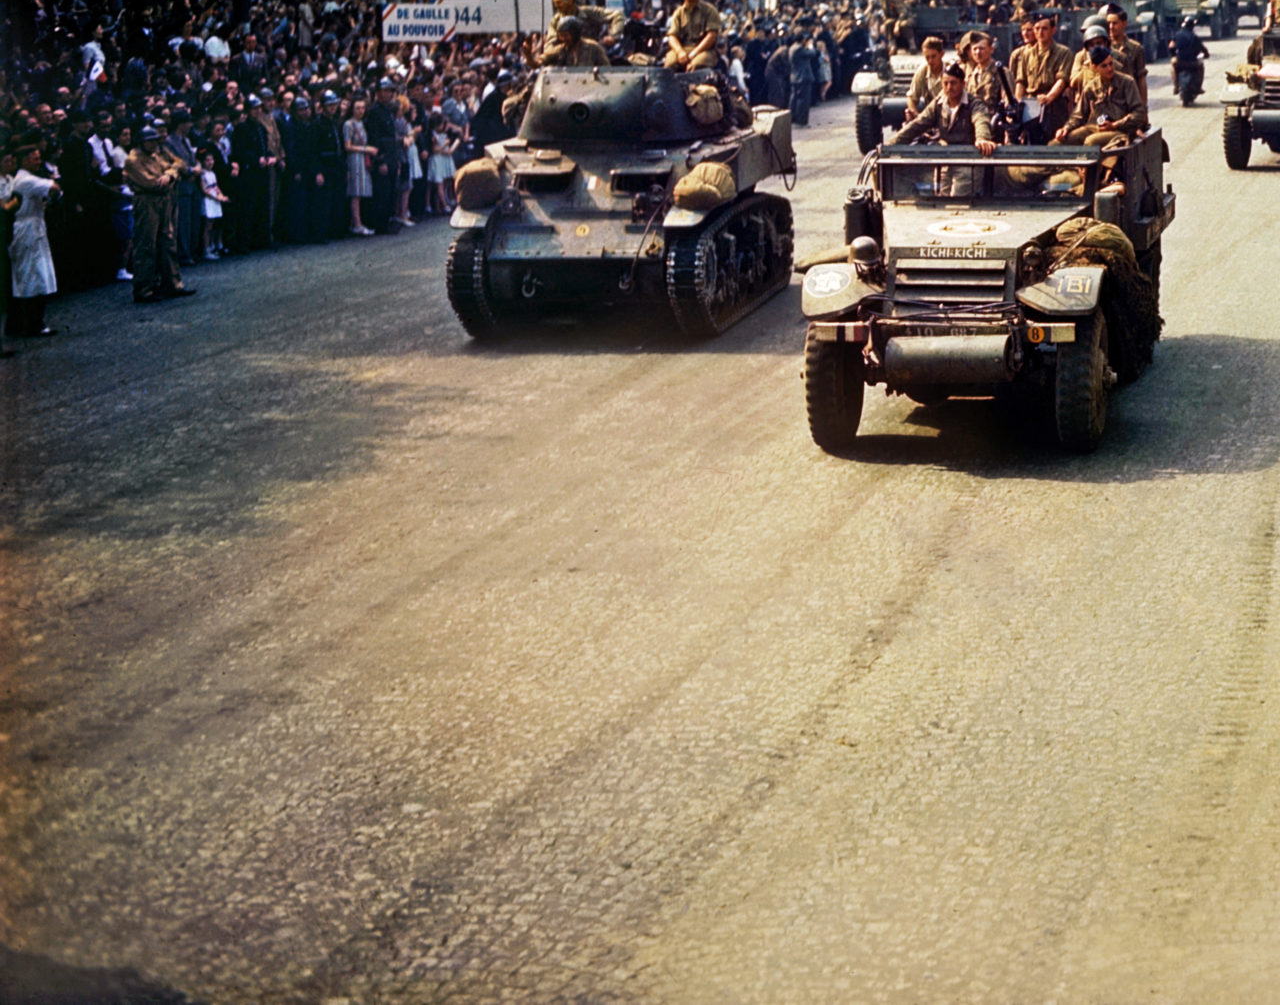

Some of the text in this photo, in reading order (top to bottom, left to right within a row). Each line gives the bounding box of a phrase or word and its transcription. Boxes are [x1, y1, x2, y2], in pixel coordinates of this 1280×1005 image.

[397, 8, 450, 20] DE GAULLE
[388, 24, 445, 36] AU POUVOIR
